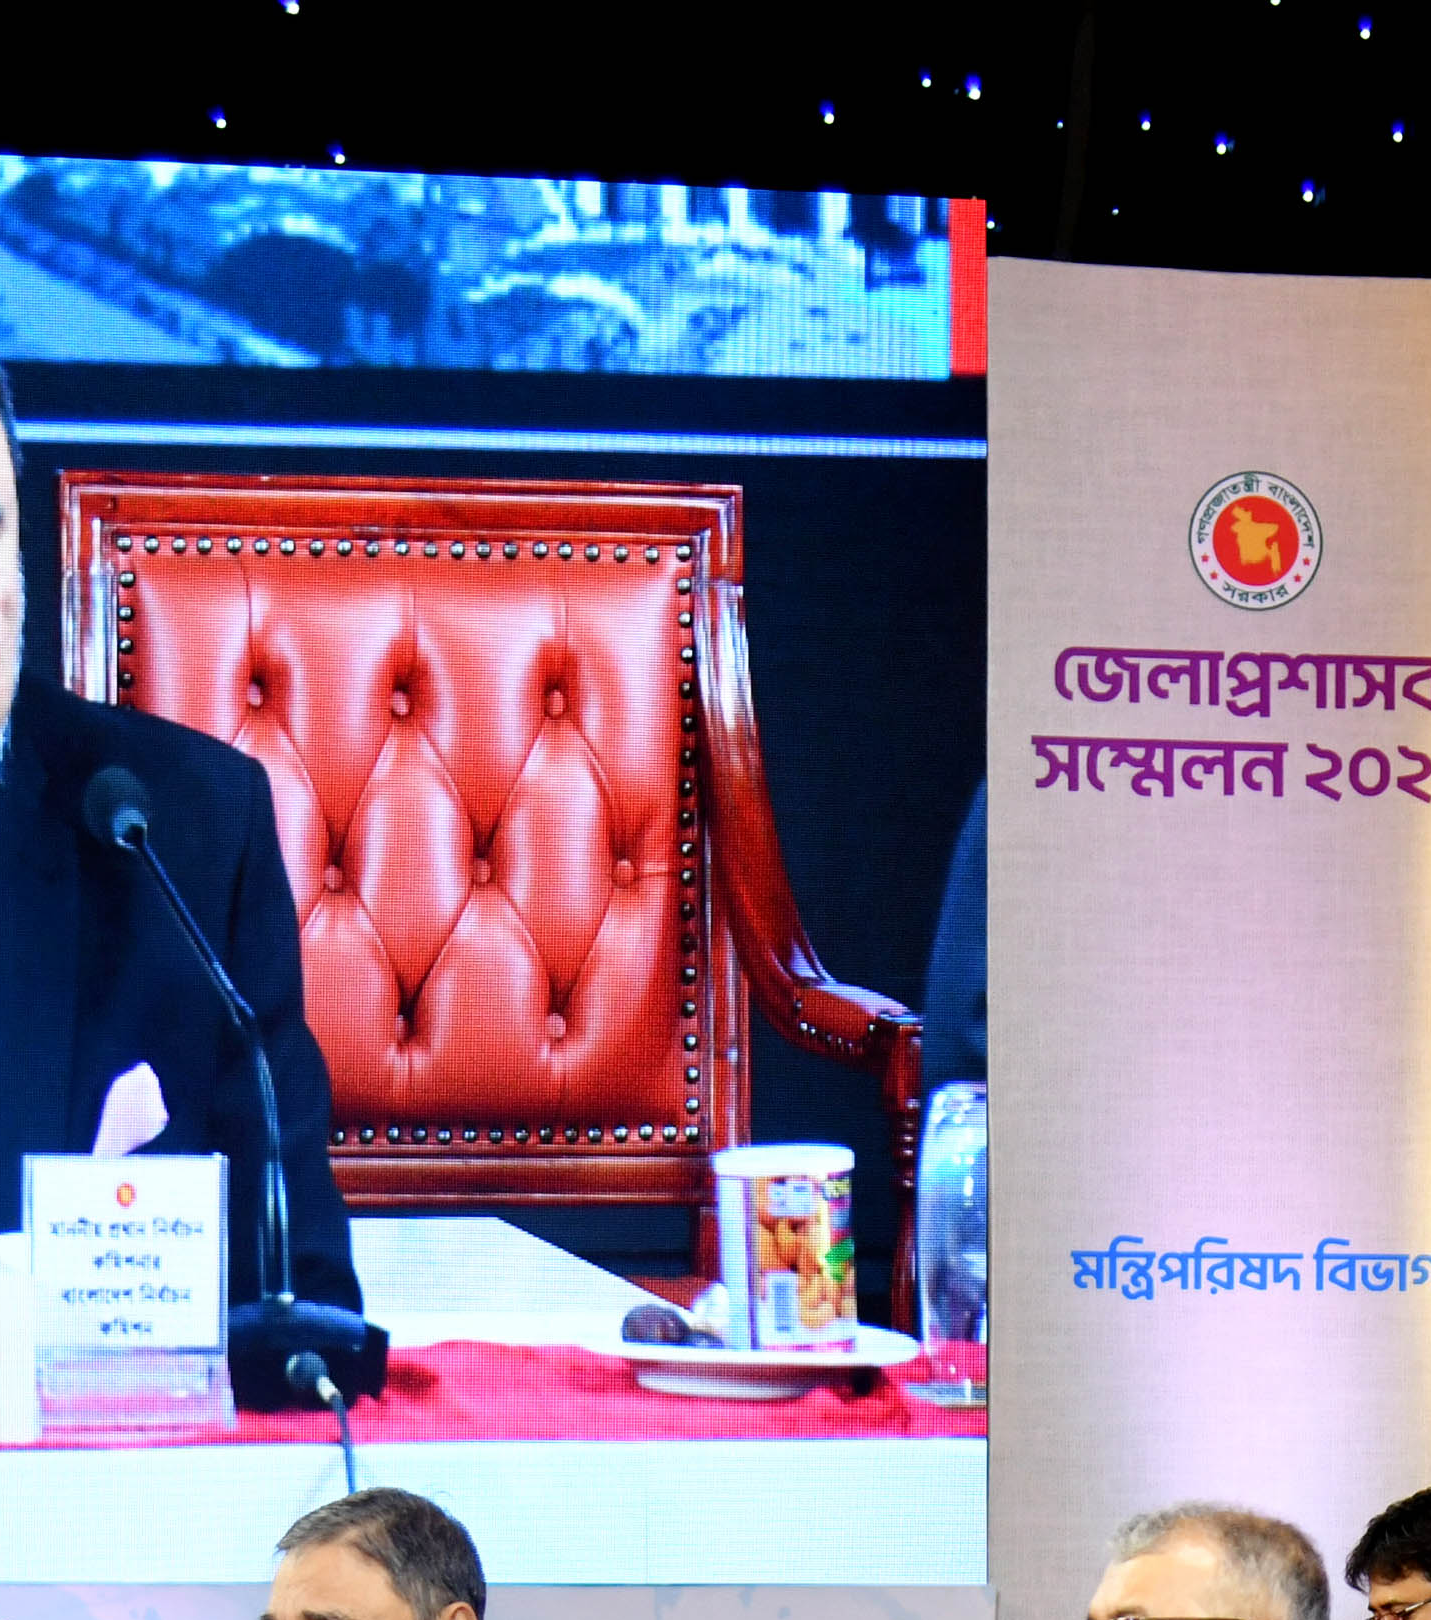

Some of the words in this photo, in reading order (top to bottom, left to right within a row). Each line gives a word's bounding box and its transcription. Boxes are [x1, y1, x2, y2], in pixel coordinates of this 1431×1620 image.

[1268, 481, 1315, 549] বাংলাদেশ
[1032, 735, 1287, 798] সম্মেলন
[1069, 1234, 1303, 1302] মন্ত্রিপরিষদ
